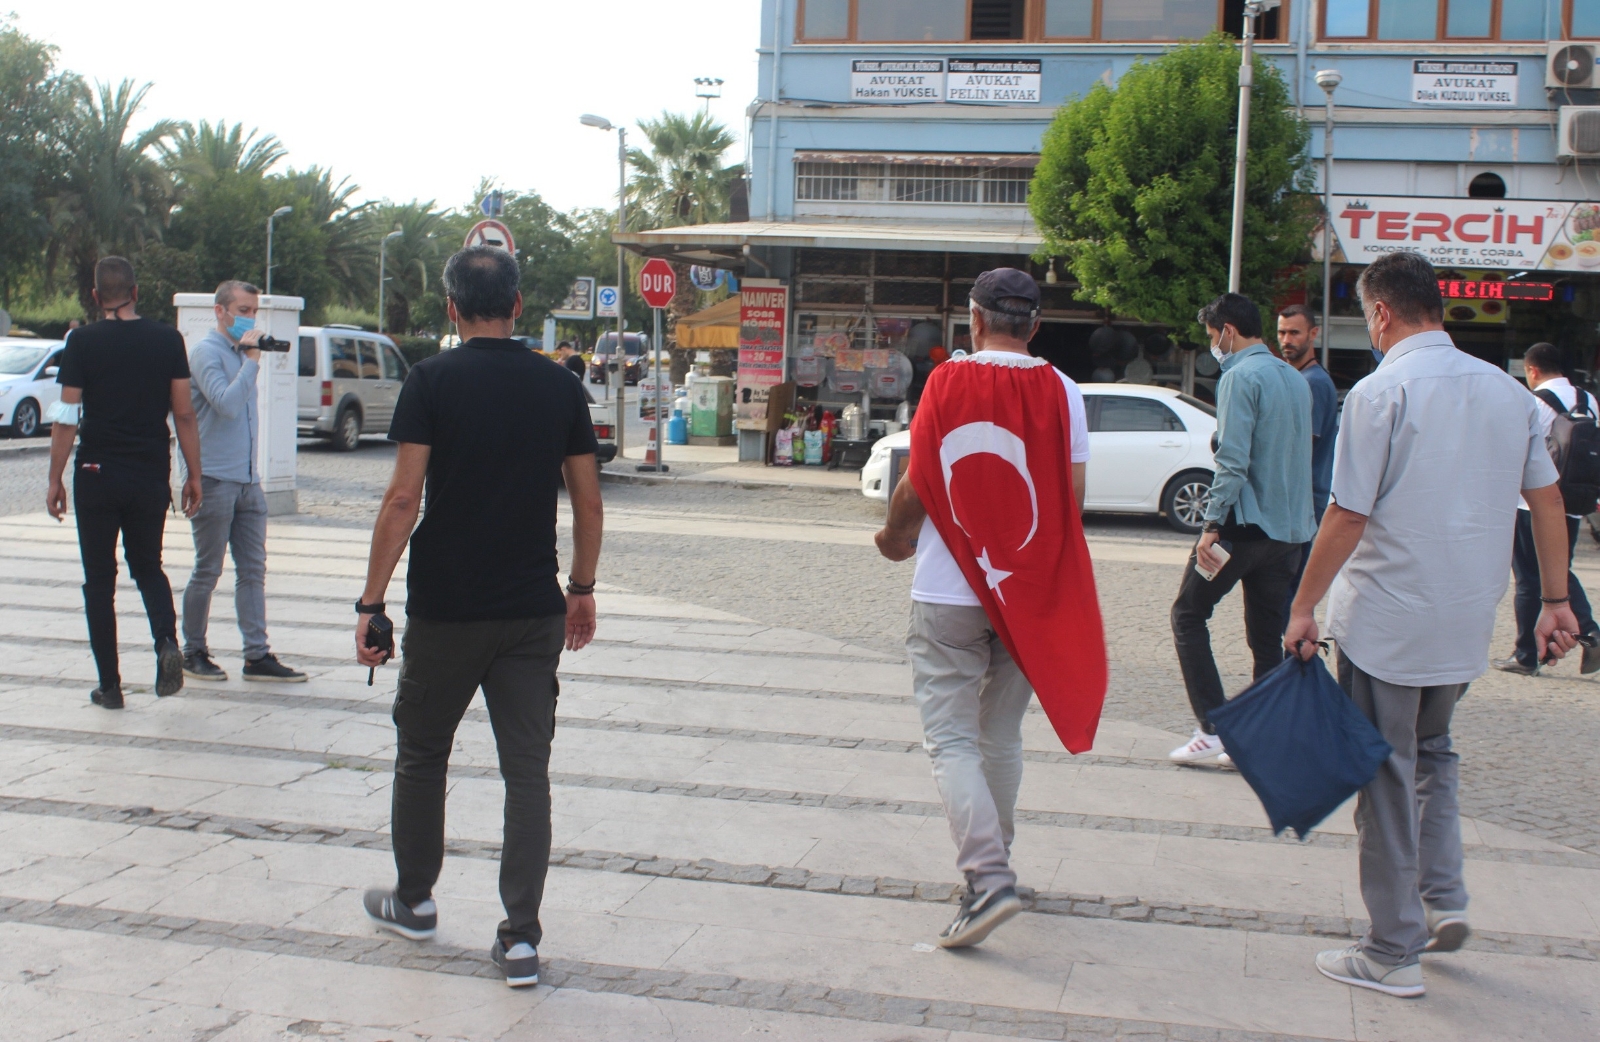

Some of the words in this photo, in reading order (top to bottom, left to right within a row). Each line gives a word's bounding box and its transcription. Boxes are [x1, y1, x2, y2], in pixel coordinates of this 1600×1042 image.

[870, 76, 925, 85] AVUKAT
[965, 75, 1022, 86] AVUKAT
[1433, 78, 1497, 88] AVUKAT
[855, 87, 890, 97] Hakan
[893, 85, 939, 97] YÜKSEL
[949, 86, 990, 99] PELİN
[993, 89, 1037, 100] KAVAK
[1417, 90, 1438, 100] Dilek
[1440, 91, 1475, 101] KUZULU
[1477, 88, 1511, 102] YÜKSEL
[1430, 245, 1470, 255] KÖFTE
[1458, 258, 1509, 266] SALONU
[642, 273, 672, 293] DUR
[742, 291, 785, 308] NAMVER
[746, 310, 775, 318] SOBA
[743, 318, 782, 328] KÖMÜR
